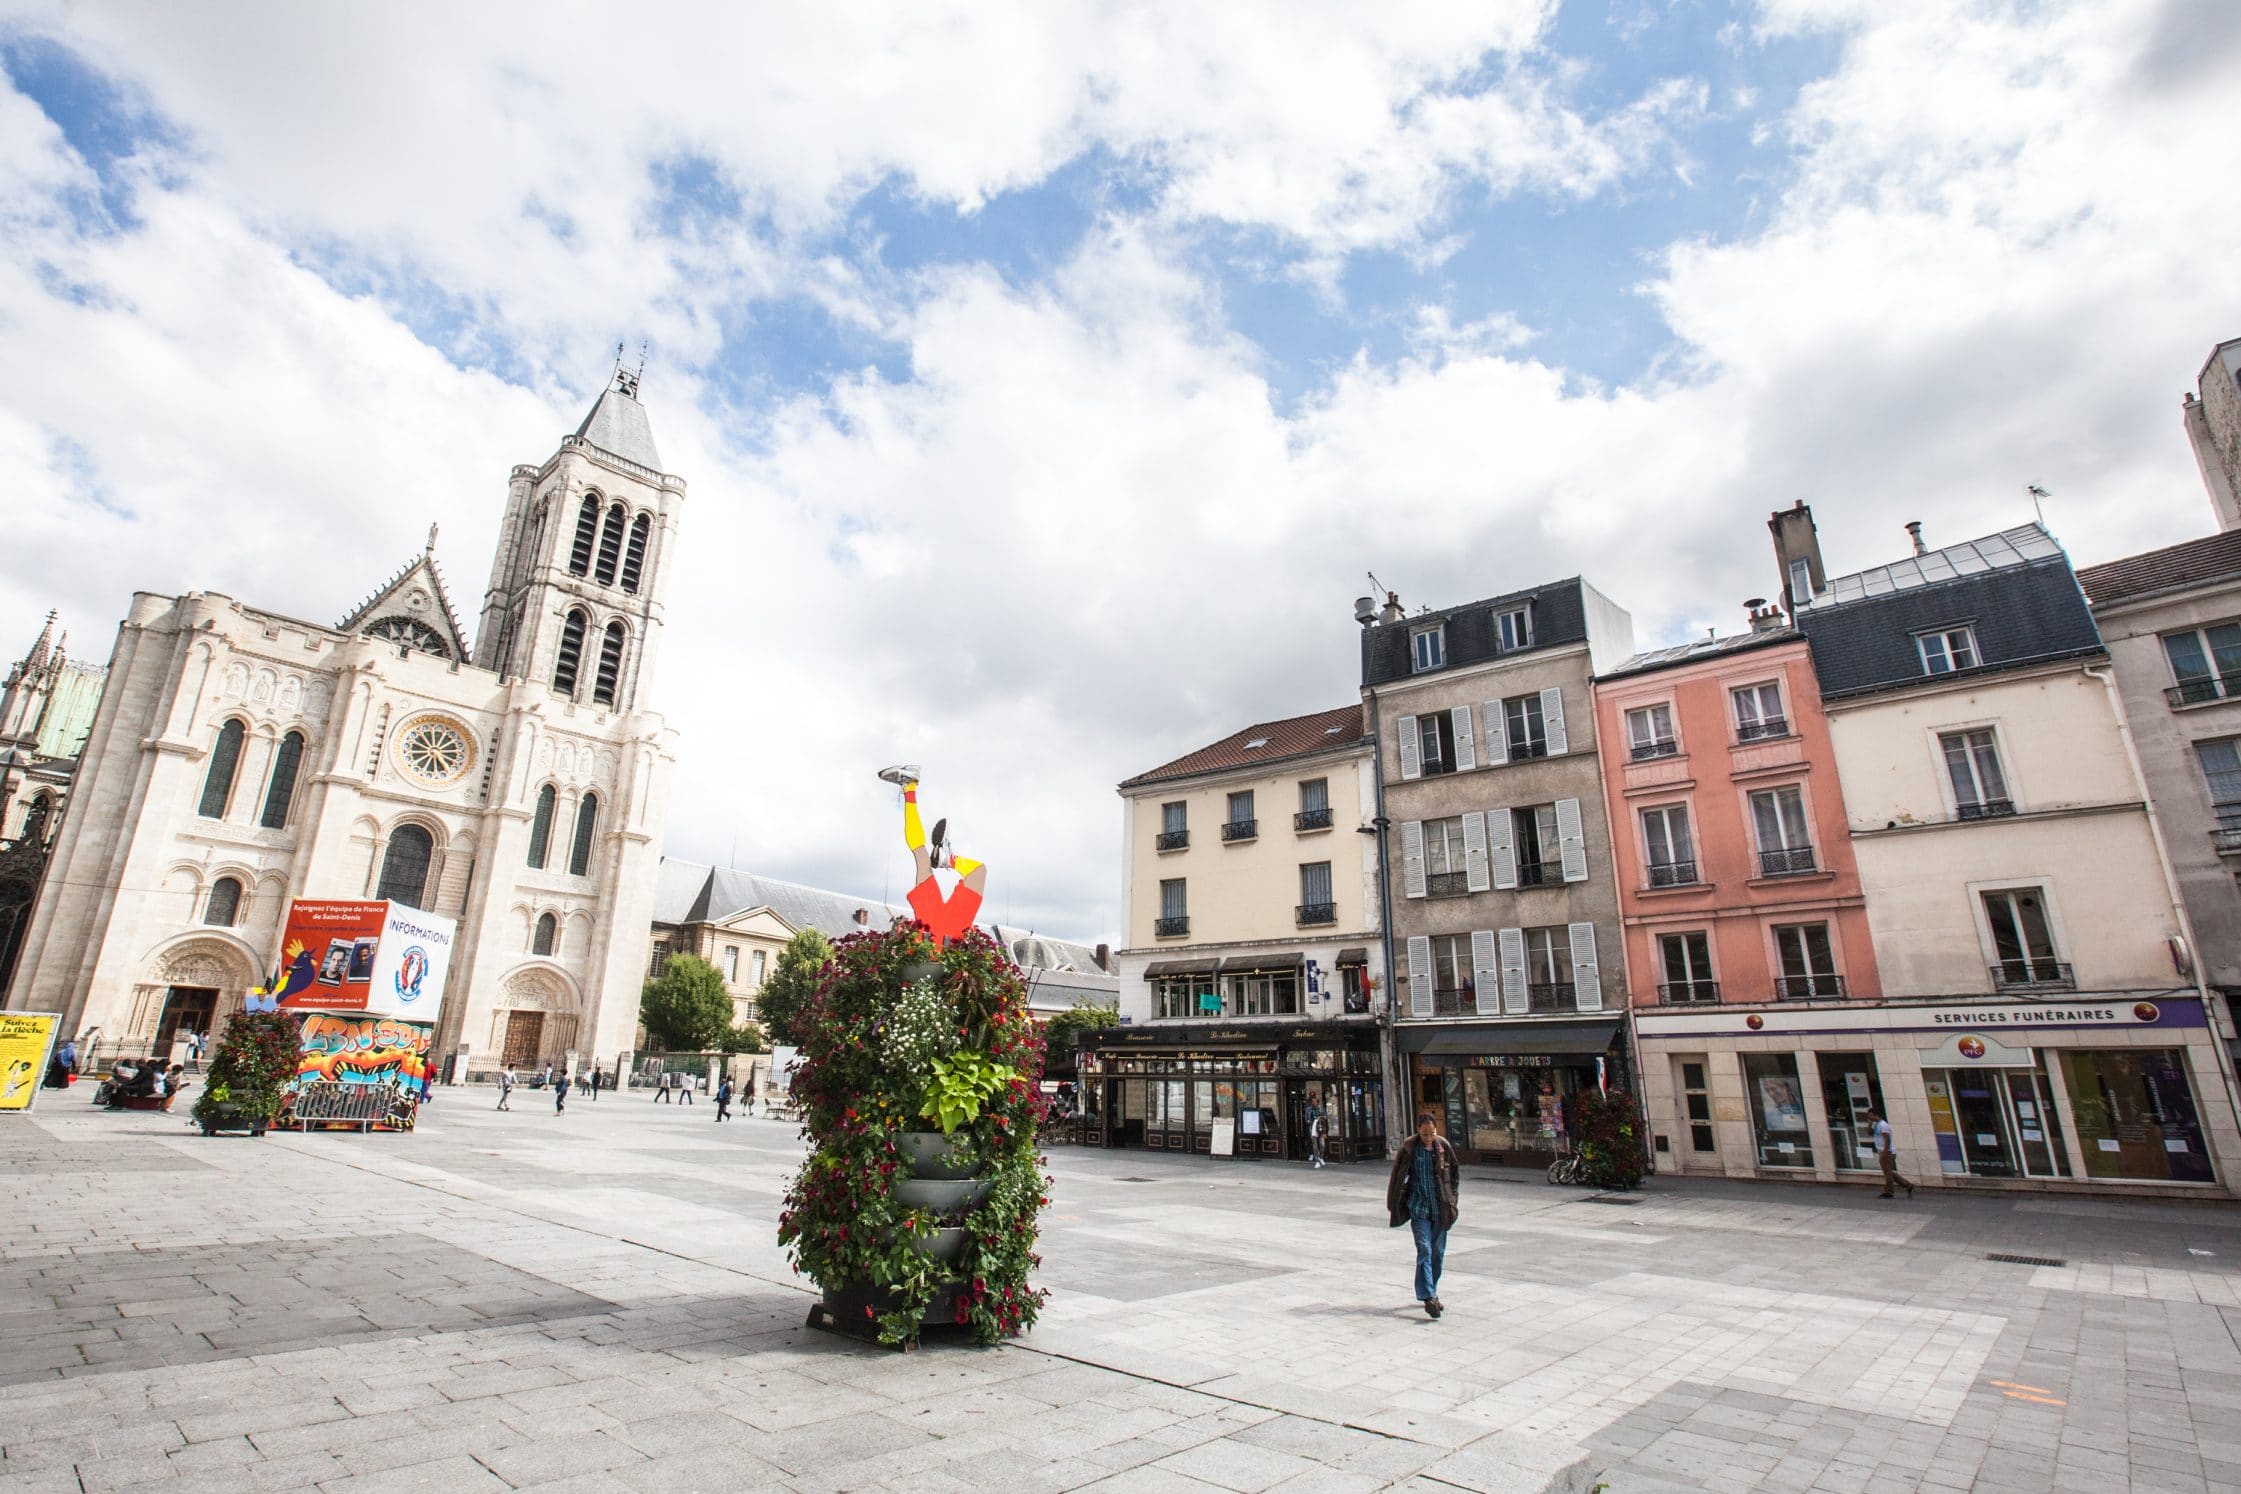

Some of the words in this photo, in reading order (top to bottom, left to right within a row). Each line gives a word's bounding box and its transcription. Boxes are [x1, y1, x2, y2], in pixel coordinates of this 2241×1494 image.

[293, 904, 325, 913] Rejoignez
[326, 905, 352, 913] l'équipe
[323, 913, 361, 921] Saint-Denis
[389, 919, 450, 945] INFORMATIONS
[1934, 1012, 2006, 1024] SERVICES
[2013, 1009, 2115, 1023] FUNÉRAIRES
[4, 1019, 37, 1027] Suivez
[13, 1026, 44, 1034] flèche
[1963, 1047, 1982, 1056] PFG
[1234, 1052, 1269, 1061] Restaurant
[1471, 1056, 1506, 1067] L'ARBRE
[1518, 1055, 1552, 1067] JOUETS
